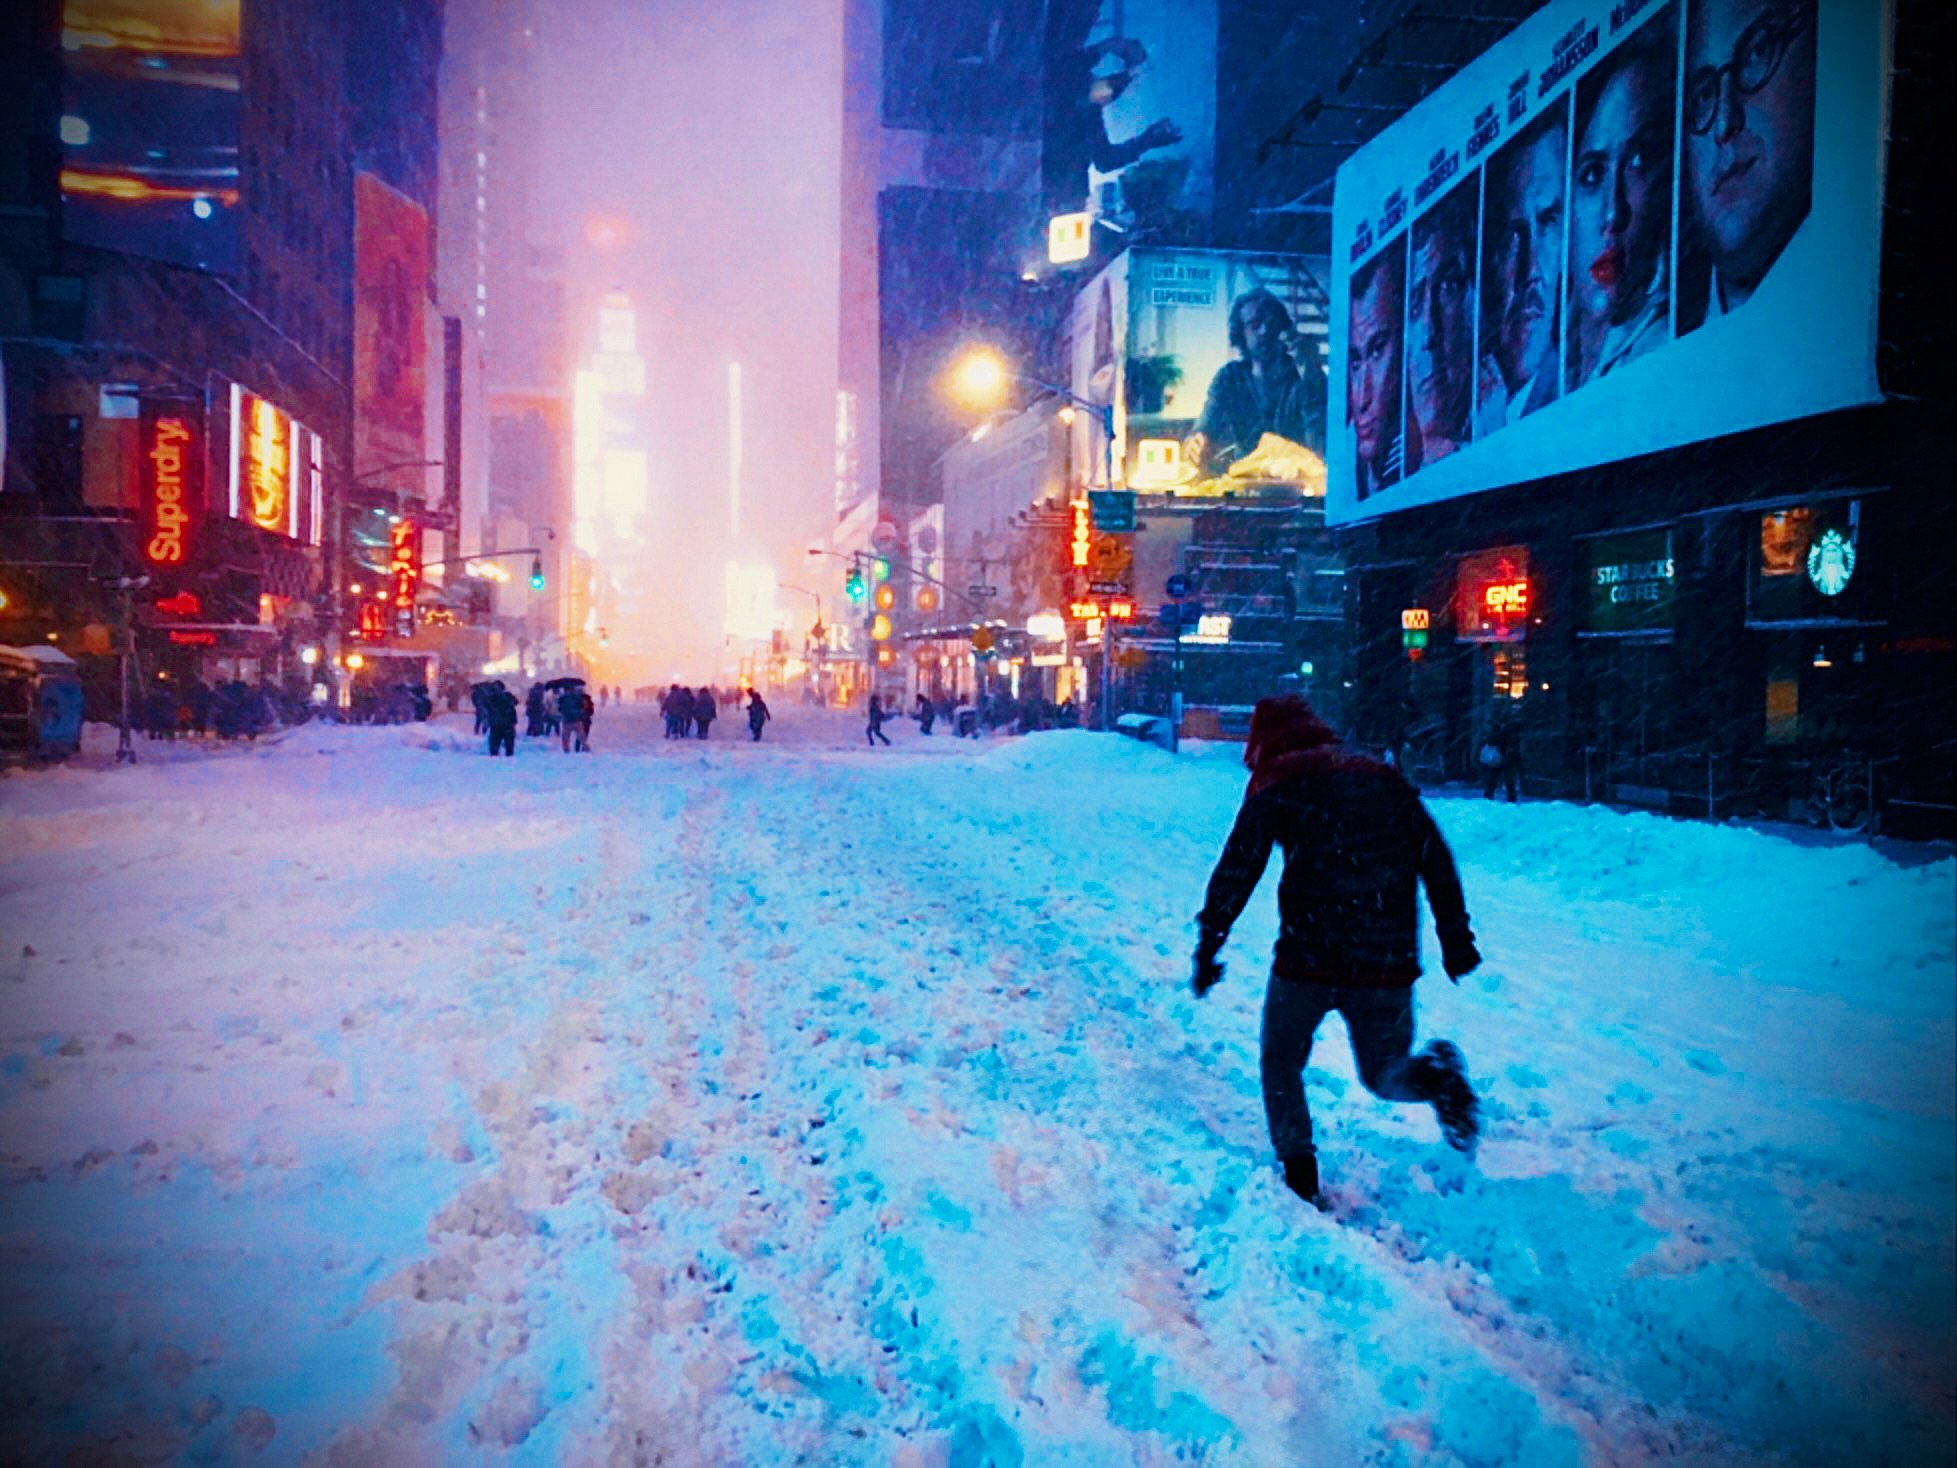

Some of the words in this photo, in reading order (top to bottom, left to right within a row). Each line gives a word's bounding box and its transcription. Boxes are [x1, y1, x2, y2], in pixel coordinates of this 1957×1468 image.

[148, 418, 190, 561] Superdry
[1597, 559, 1675, 584] STARBUCKS
[1486, 583, 1527, 605] GNC
[1610, 581, 1659, 603] COFFEE
